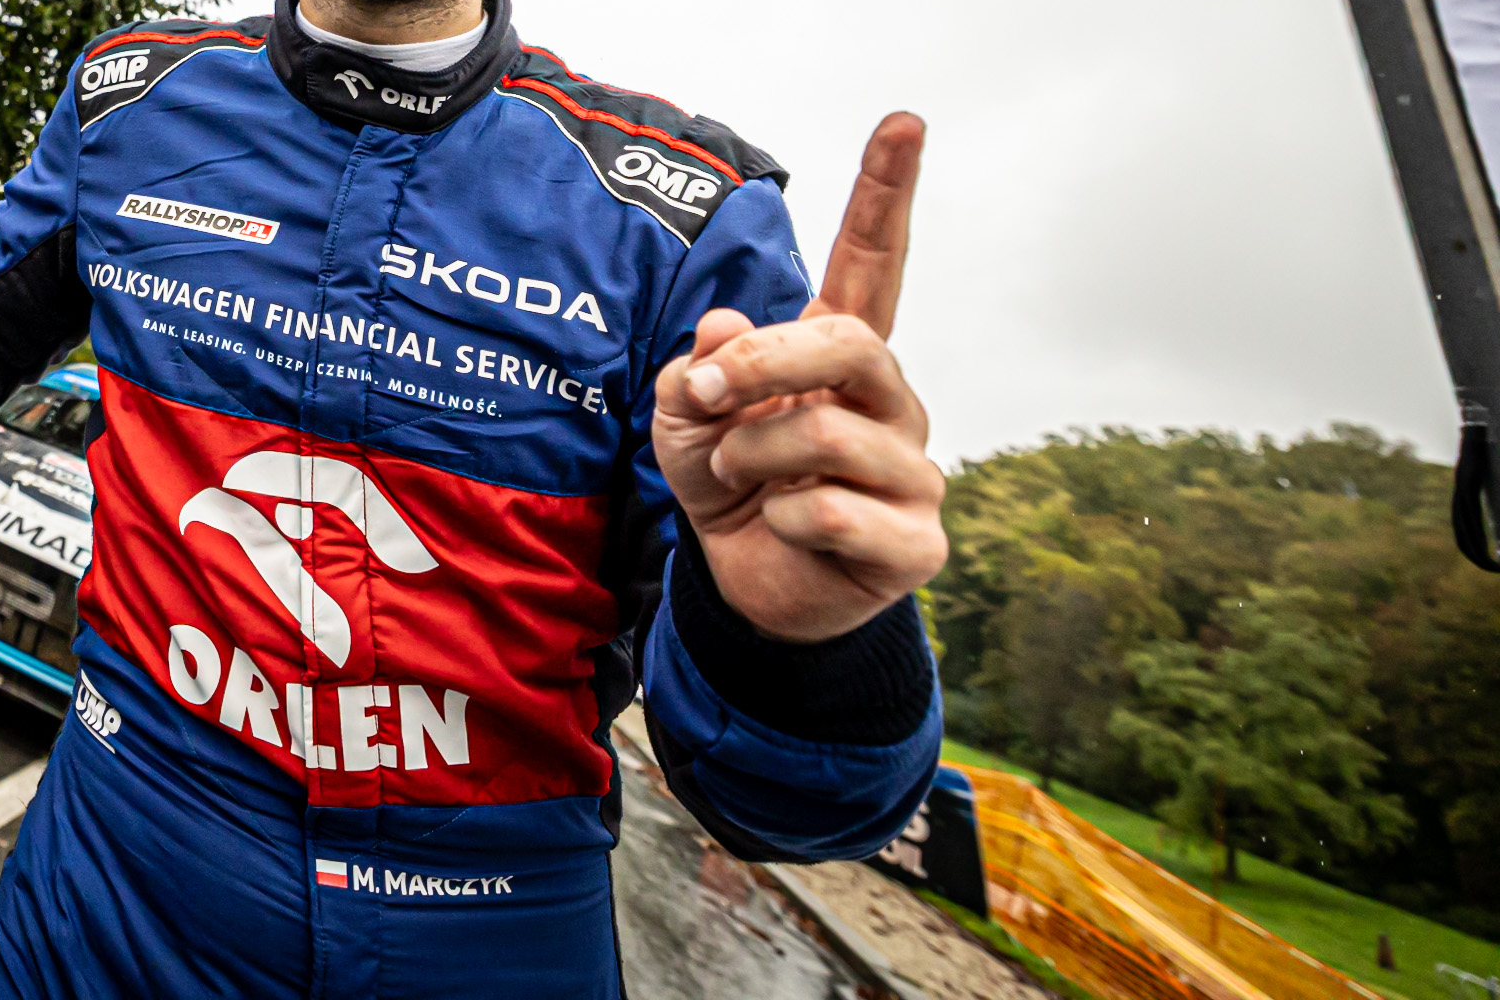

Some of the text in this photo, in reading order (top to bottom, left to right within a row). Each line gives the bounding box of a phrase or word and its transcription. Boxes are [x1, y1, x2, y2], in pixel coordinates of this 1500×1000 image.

[81, 55, 149, 91] OMP
[381, 87, 452, 115] ORLE
[615, 152, 718, 203] OMP
[88, 264, 608, 415] VOLKSWAGEN FINANCIAL SERVICE
[142, 318, 502, 418] BANK. LEASING. UBEZPICZENIA. MOBILNOŚĆ.
[75, 681, 122, 737] OMP
[168, 624, 470, 771] ORLEN
